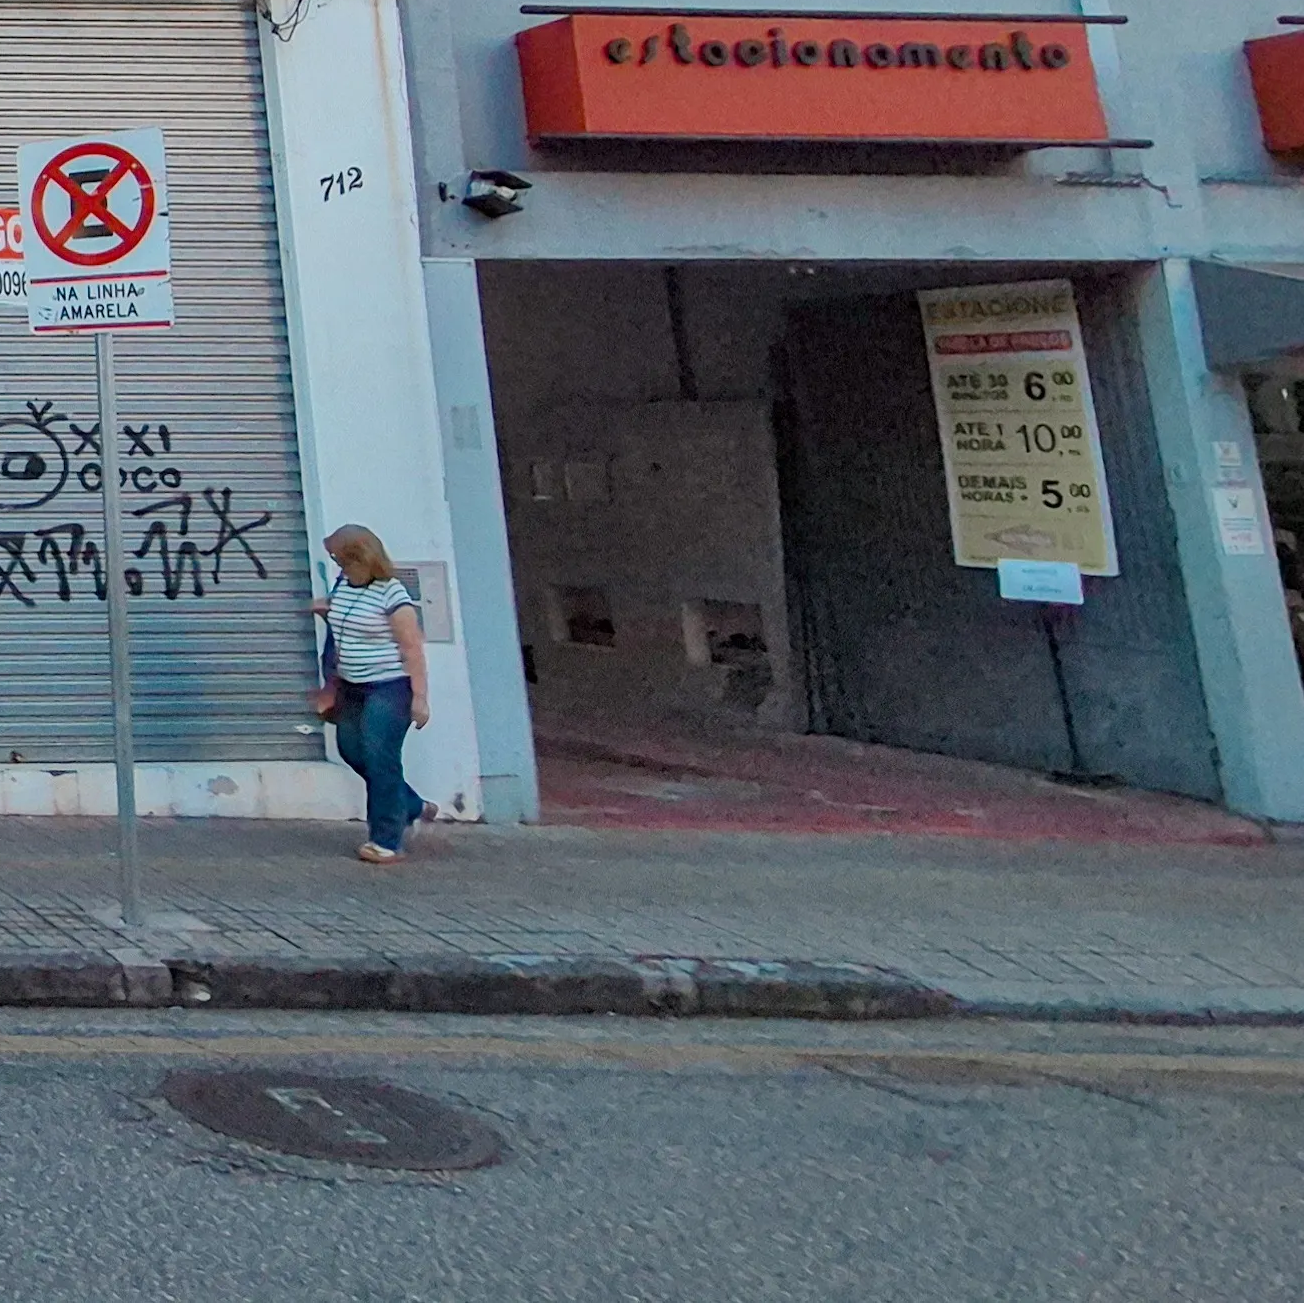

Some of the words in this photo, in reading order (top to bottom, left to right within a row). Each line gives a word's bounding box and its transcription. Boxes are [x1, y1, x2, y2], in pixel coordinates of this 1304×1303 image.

[320, 166, 363, 202] 712
[56, 287, 79, 302] NA
[87, 283, 139, 300] LINHA
[60, 303, 139, 320] AMARELA
[1024, 371, 1046, 401] 6
[1016, 423, 1056, 454] 10
[958, 475, 1027, 490] DEMAIS
[1042, 480, 1063, 509] 5
